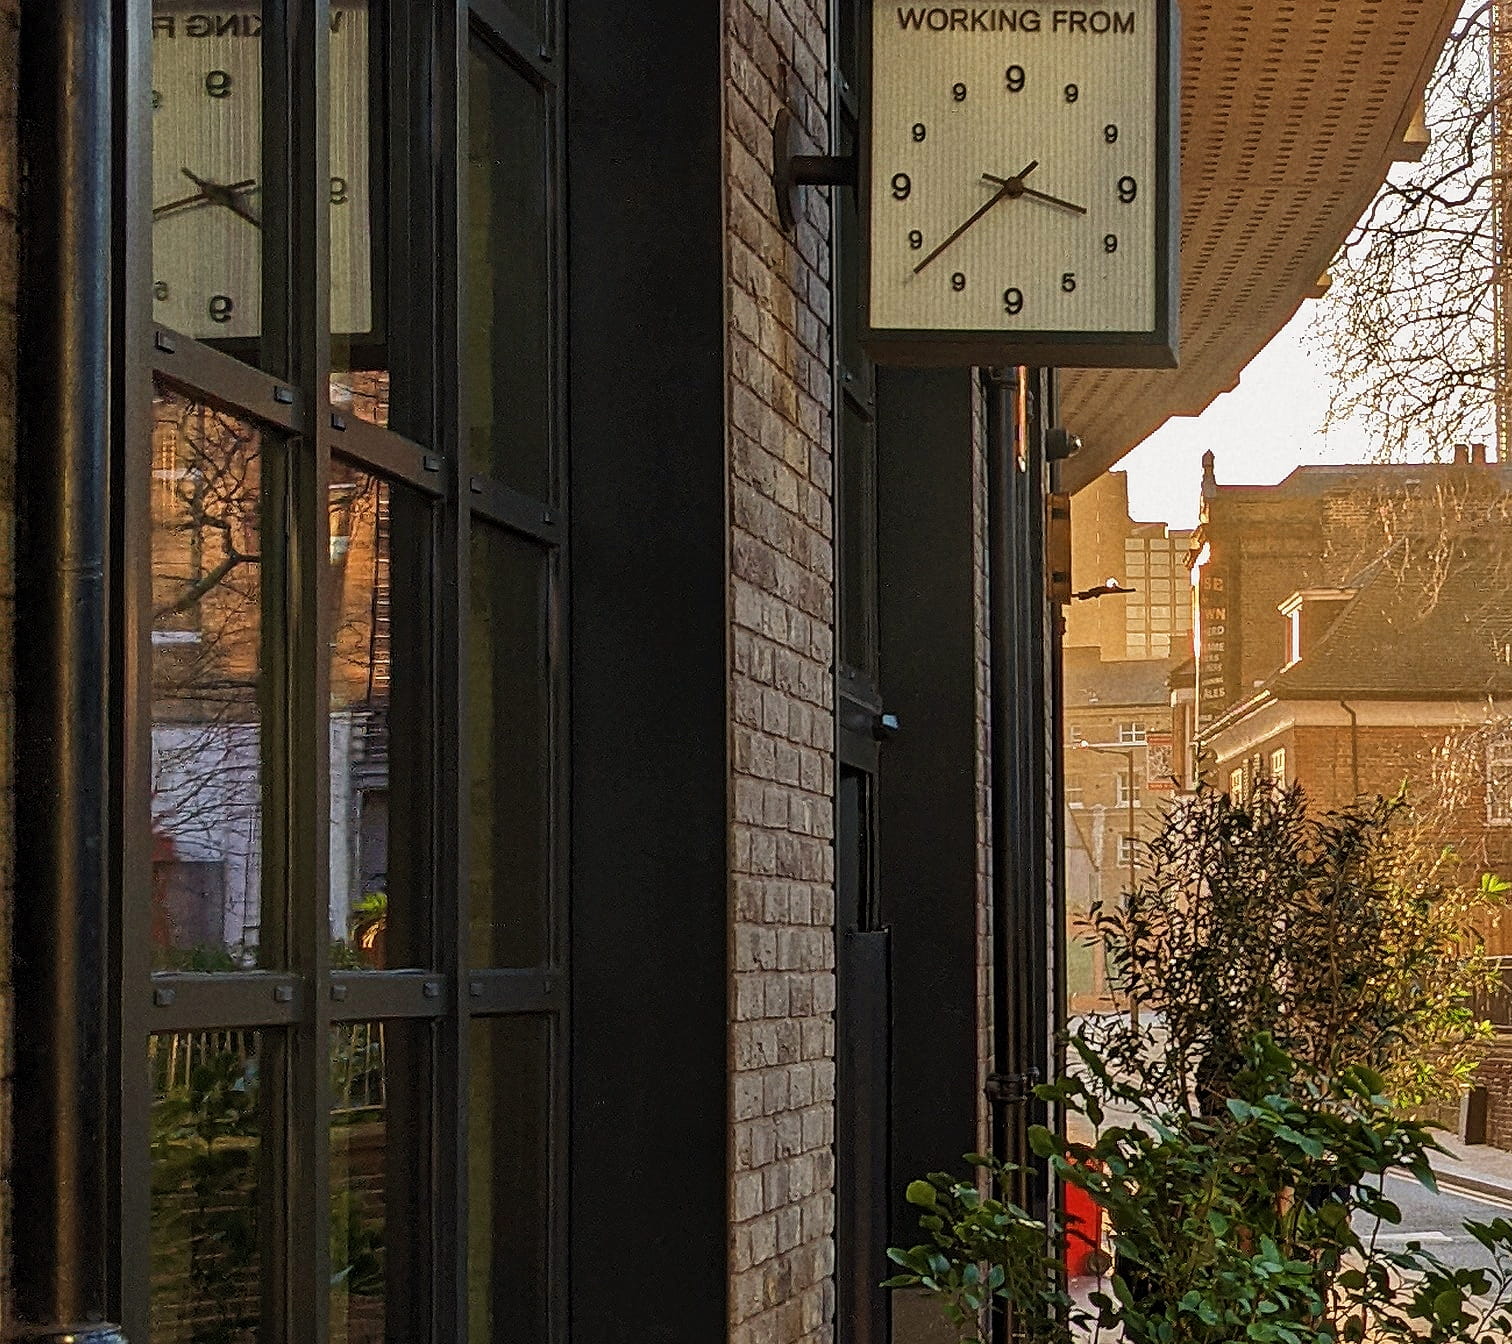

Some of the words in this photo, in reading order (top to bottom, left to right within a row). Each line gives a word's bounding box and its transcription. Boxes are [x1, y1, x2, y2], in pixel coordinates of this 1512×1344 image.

[897, 7, 1041, 33] WORKING
[1052, 9, 1135, 35] FROM
[1005, 64, 1026, 94] 9
[952, 82, 967, 103] 9
[1063, 83, 1079, 104] 9
[911, 122, 927, 143] 9
[1103, 124, 1119, 145] 9
[890, 172, 912, 202] 9
[1116, 175, 1138, 204] 9
[908, 229, 923, 251] 9
[1103, 233, 1118, 255] 9
[951, 272, 966, 293] 9
[1061, 272, 1077, 294] 5
[1002, 287, 1024, 316] 9
